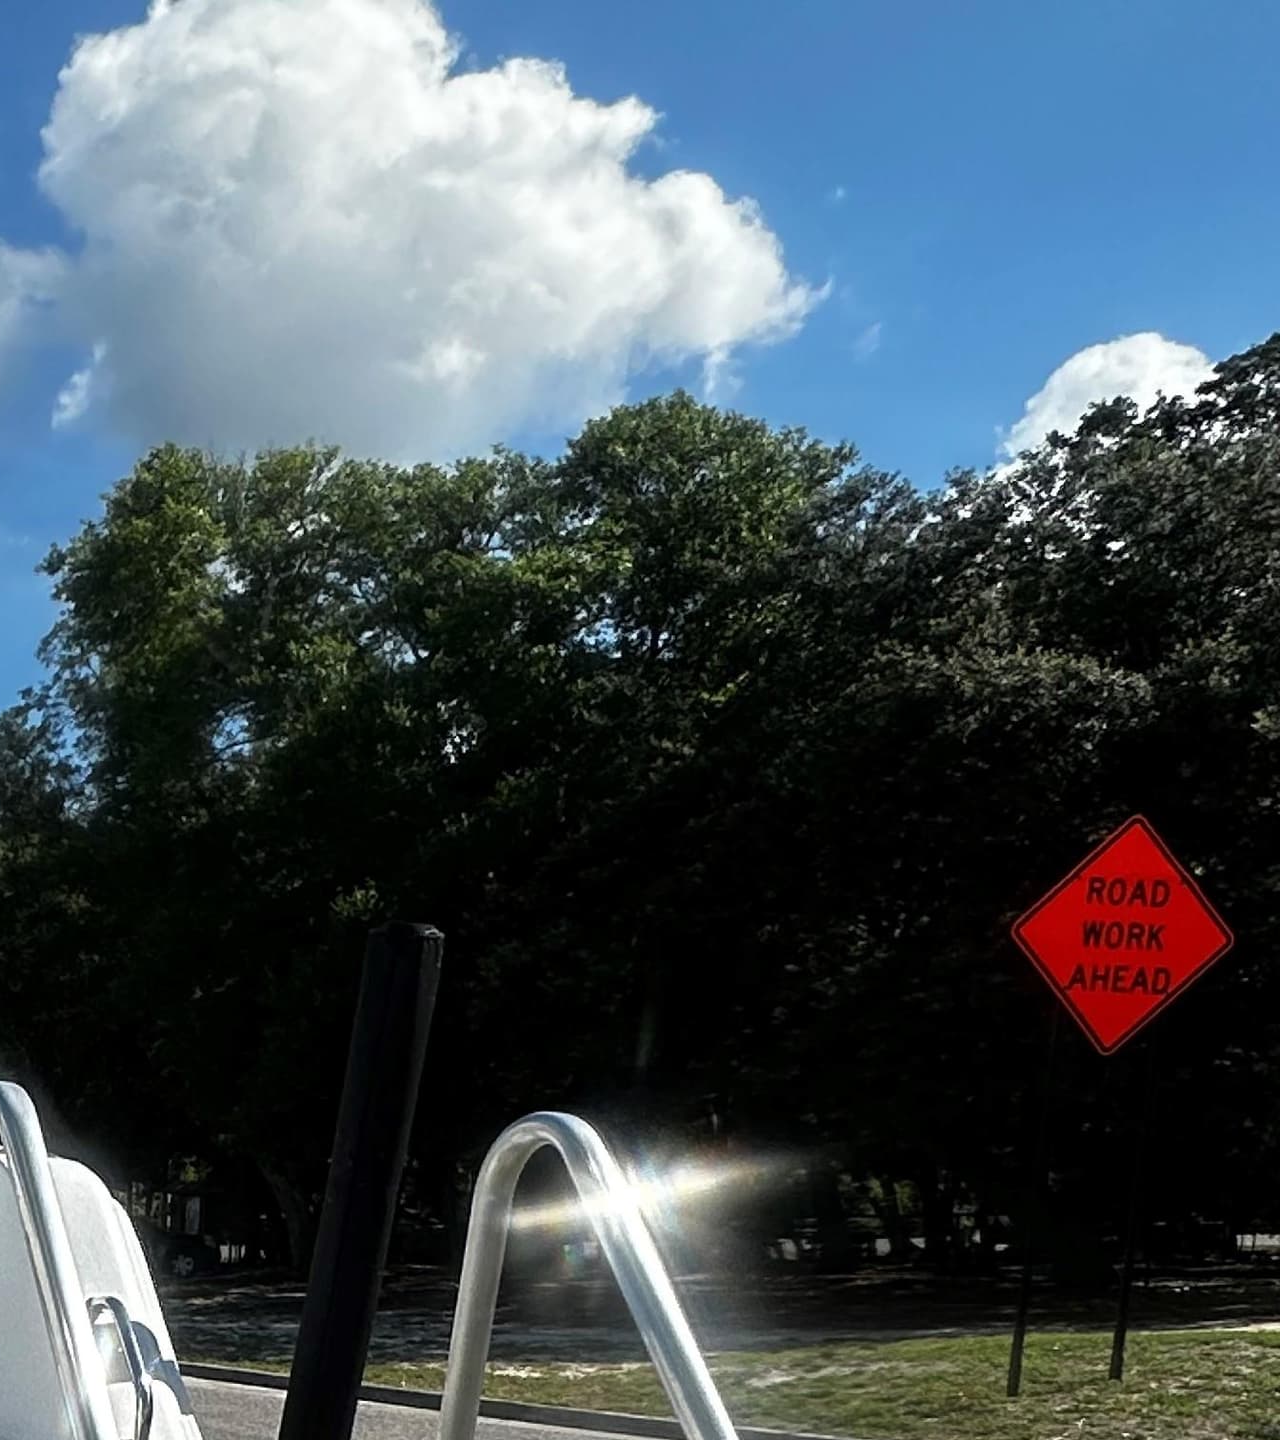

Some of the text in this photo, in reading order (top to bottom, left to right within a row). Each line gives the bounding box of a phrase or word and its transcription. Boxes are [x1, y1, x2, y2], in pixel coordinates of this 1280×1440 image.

[1086, 876, 1171, 908] ROAD
[1081, 920, 1166, 952] WORK
[1067, 964, 1172, 996] AHEAD
